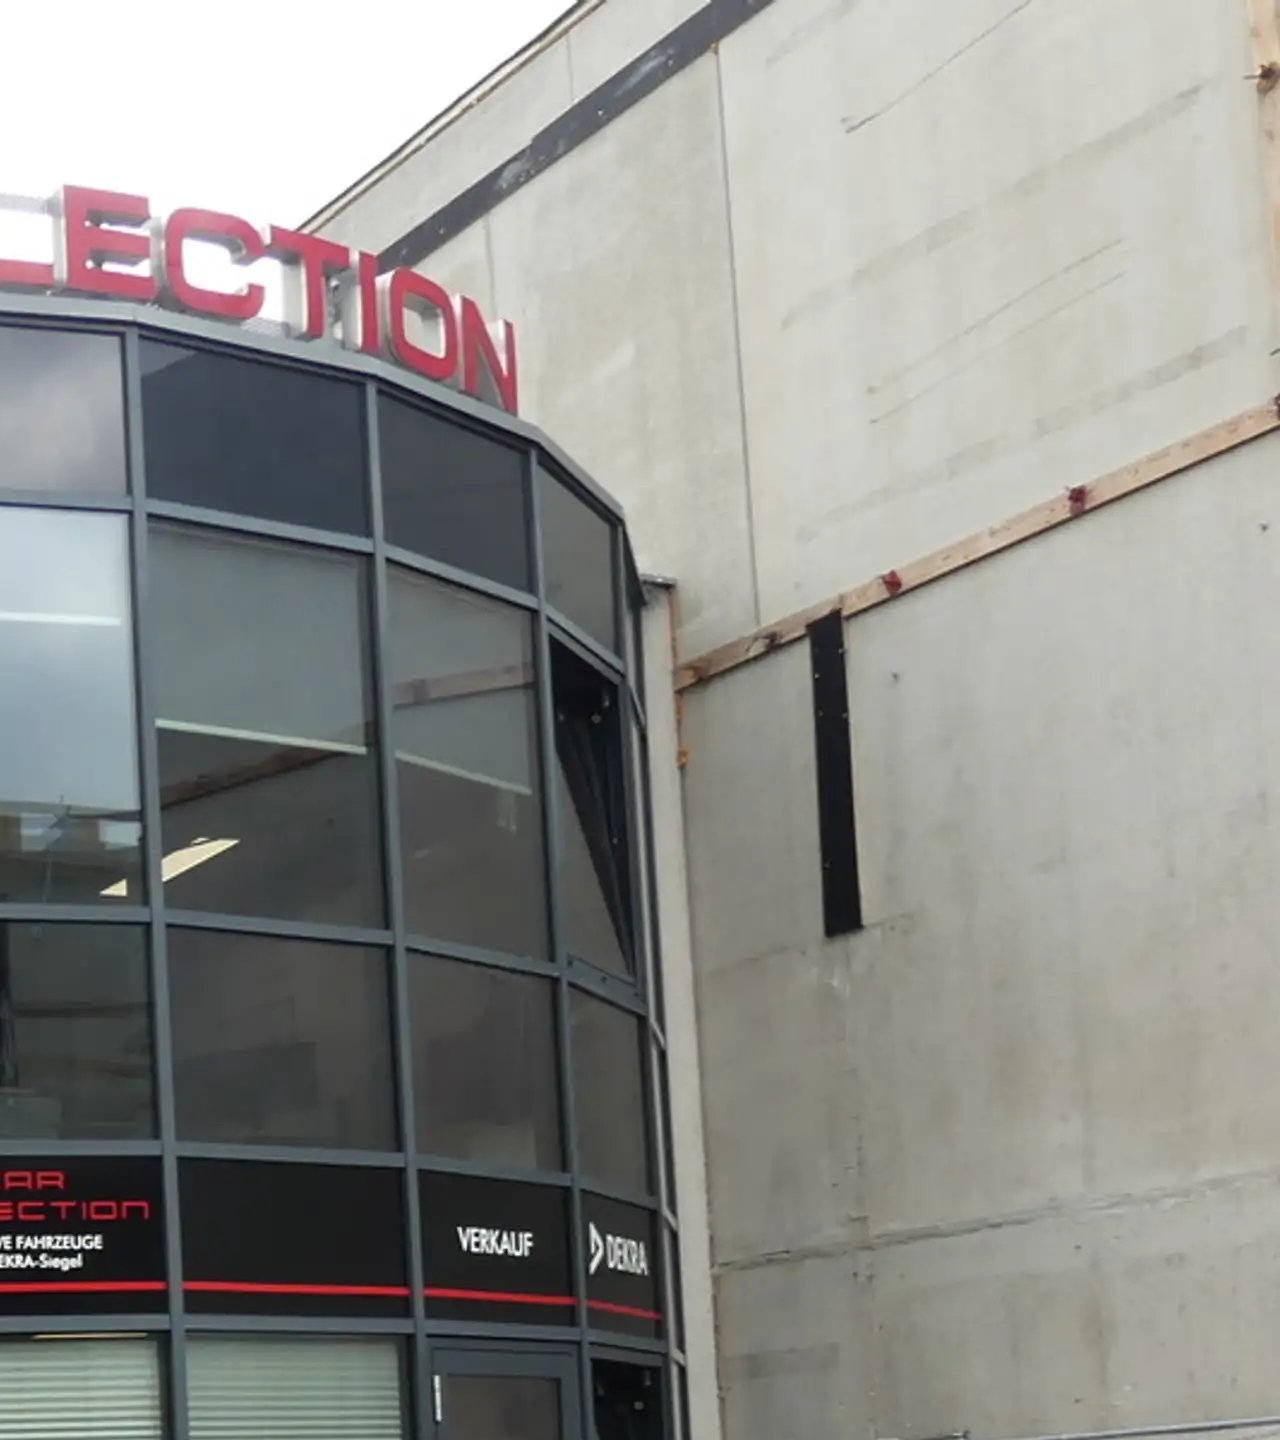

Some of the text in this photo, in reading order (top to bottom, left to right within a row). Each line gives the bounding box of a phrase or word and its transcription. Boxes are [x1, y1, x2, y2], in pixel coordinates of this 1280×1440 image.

[15, 1234, 103, 1250] FAHRZEUGE
[456, 1226, 534, 1257] VERKAUF
[605, 1233, 649, 1276] DEKRA
